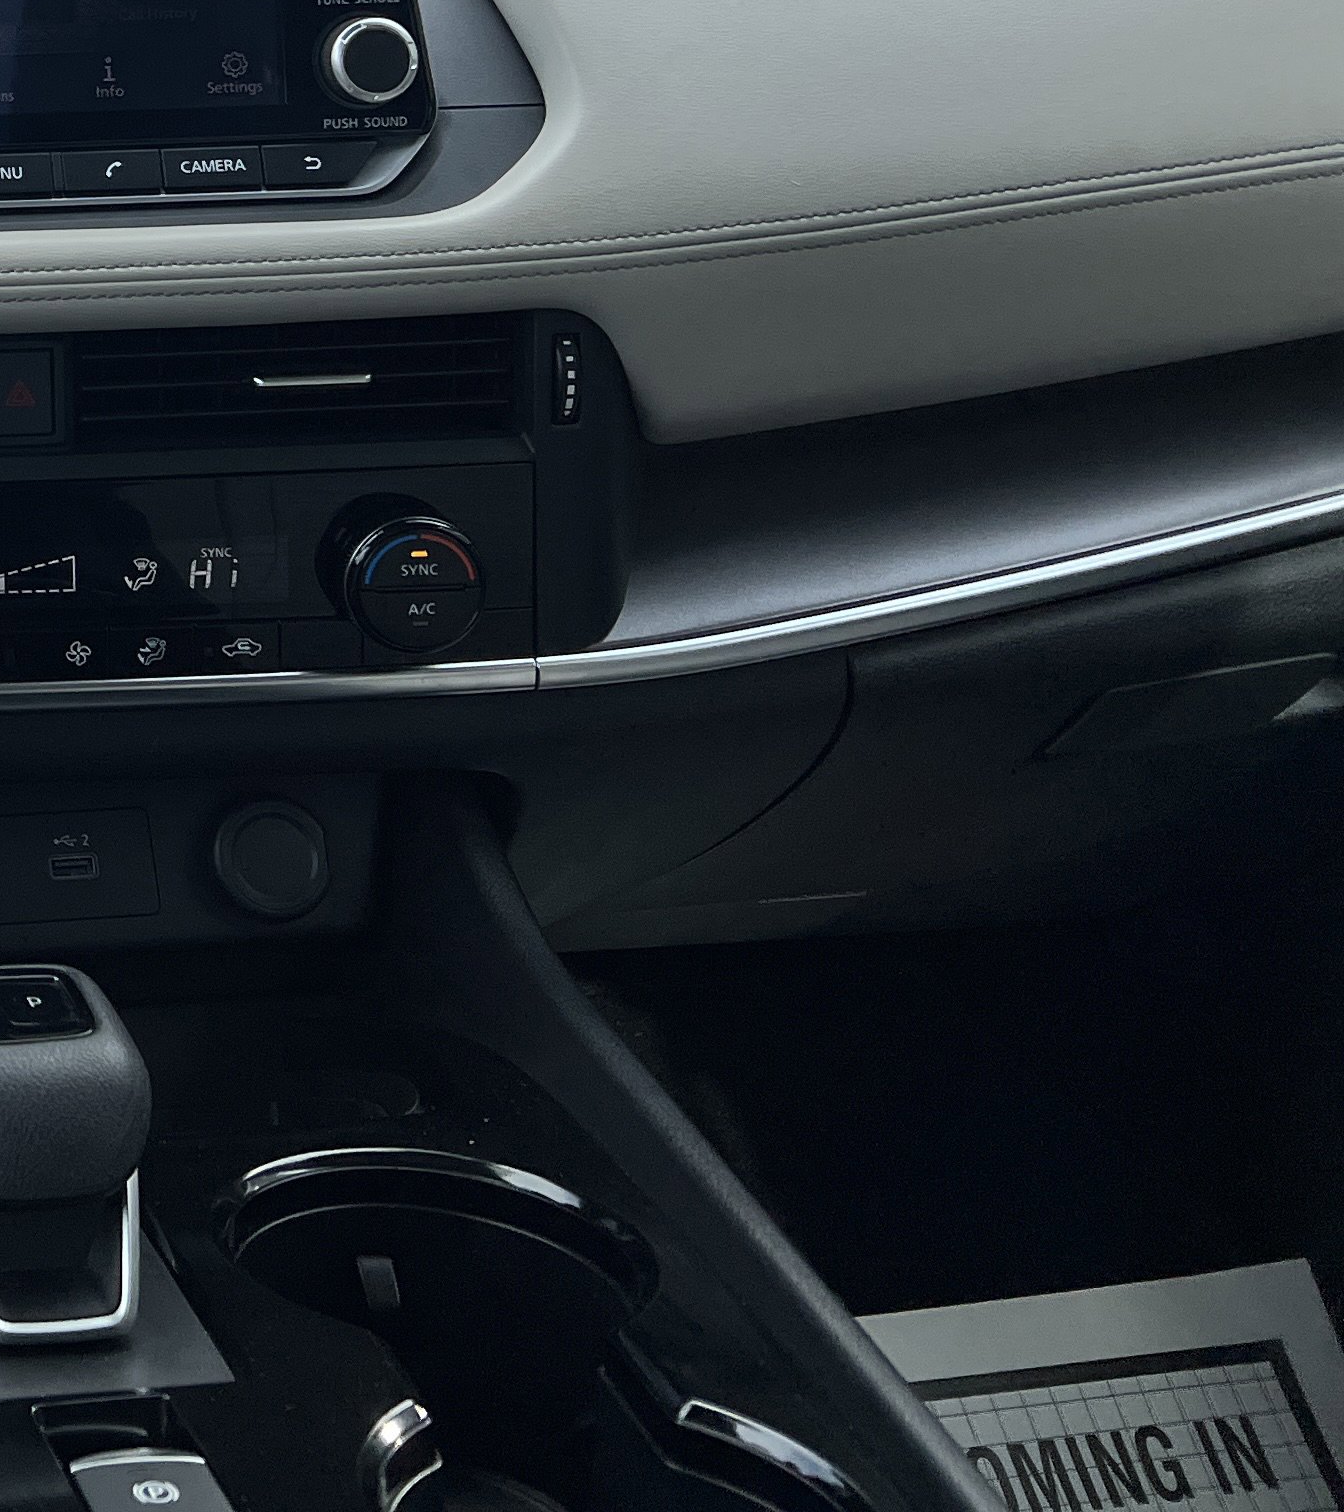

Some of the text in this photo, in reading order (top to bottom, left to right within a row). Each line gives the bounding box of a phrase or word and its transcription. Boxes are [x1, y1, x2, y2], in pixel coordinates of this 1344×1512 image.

[95, 85, 125, 98] Info
[207, 80, 263, 95] Settings
[323, 115, 408, 129] PUSH SOUND
[180, 158, 247, 174] CAMERA
[200, 547, 233, 559] SYNC
[400, 563, 439, 577] SYNC
[408, 602, 436, 616] A/C
[81, 834, 90, 847] 2
[26, 996, 43, 1008] P
[1194, 1414, 1280, 1495] IN
